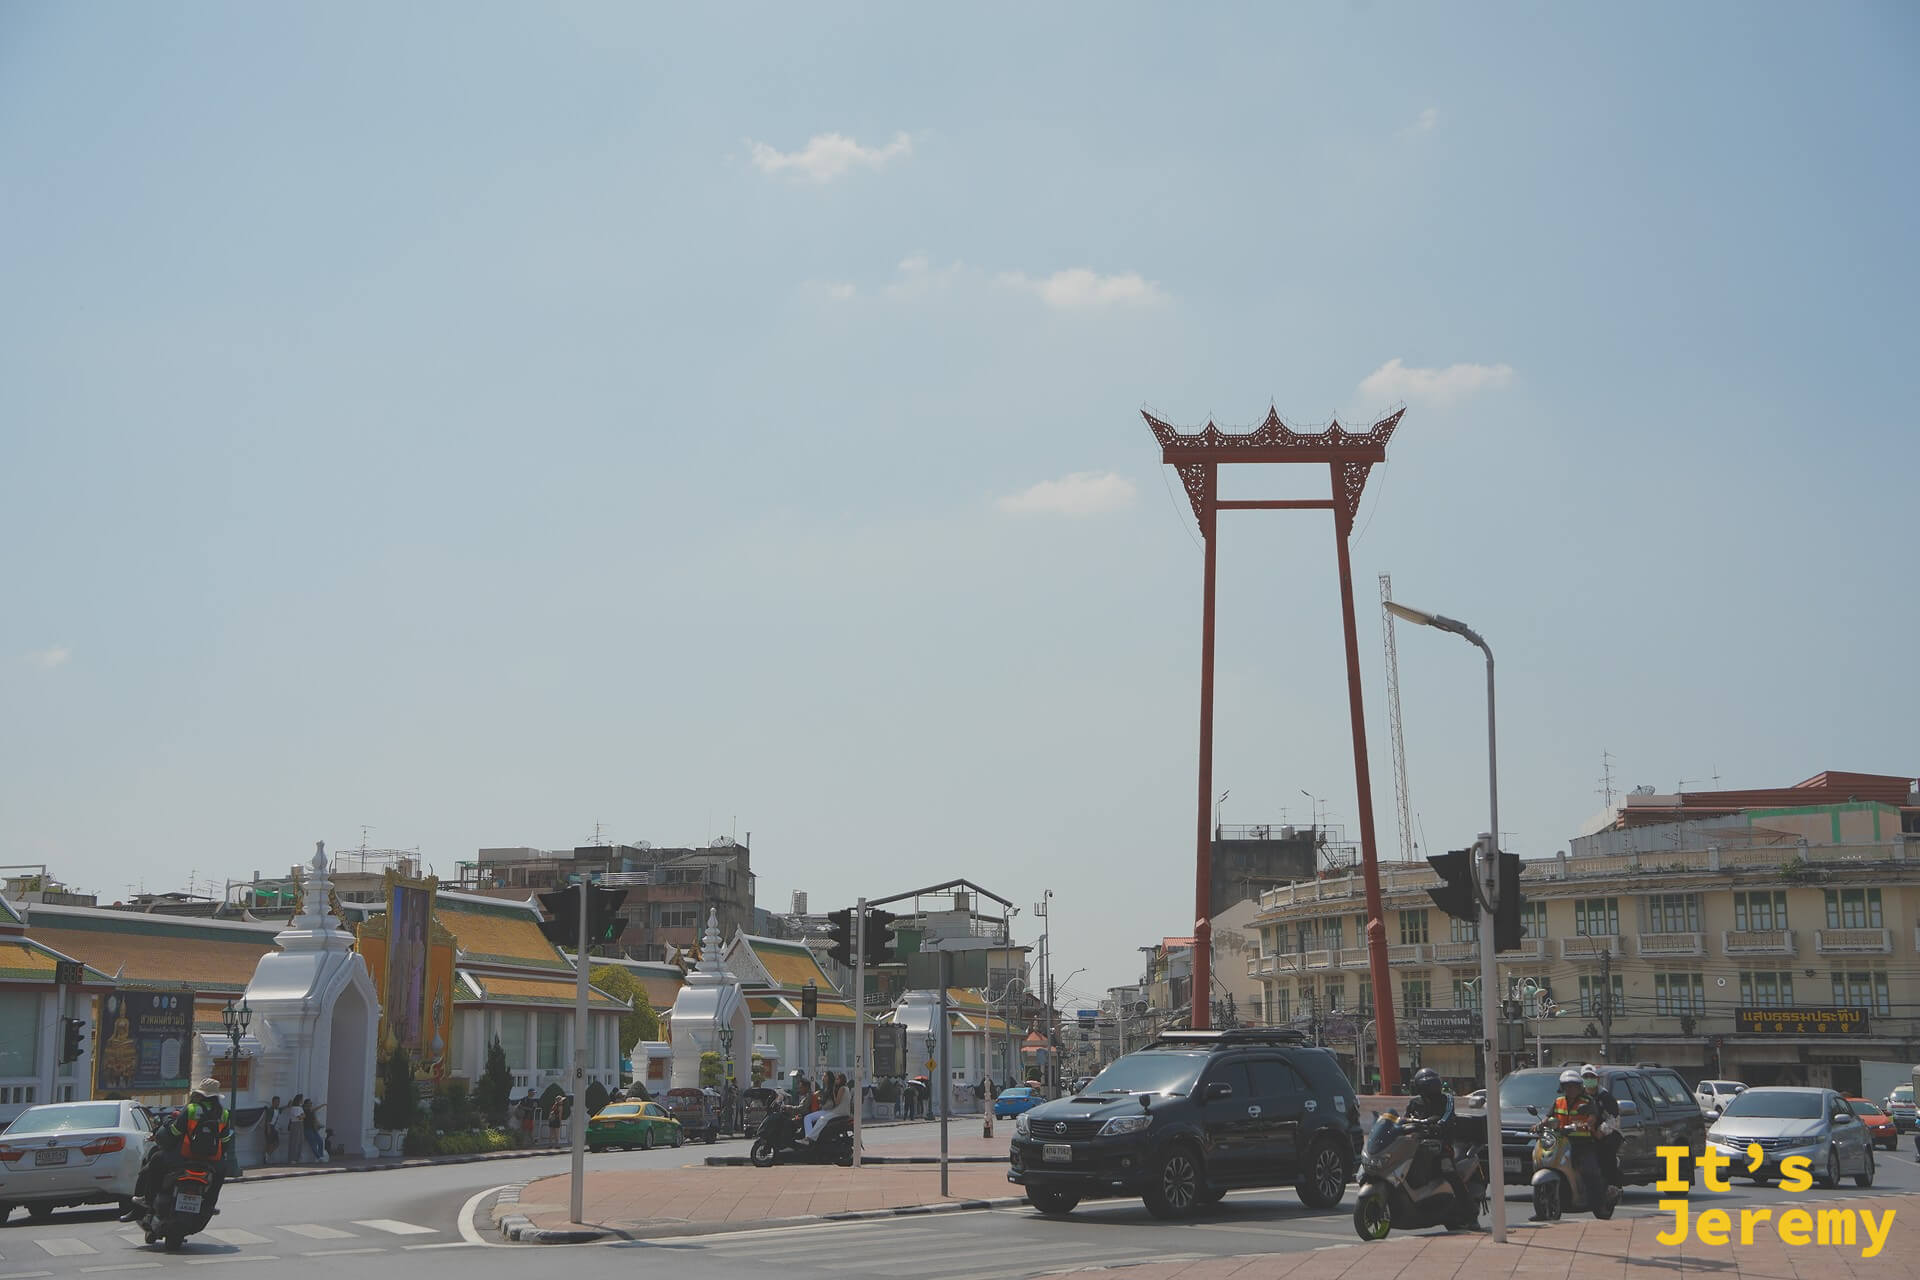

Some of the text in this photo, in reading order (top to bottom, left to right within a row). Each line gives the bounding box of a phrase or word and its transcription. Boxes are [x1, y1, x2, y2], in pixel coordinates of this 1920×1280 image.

[1743, 1009, 1860, 1022] แสงธรรมประทีป
[576, 1067, 582, 1079] 8
